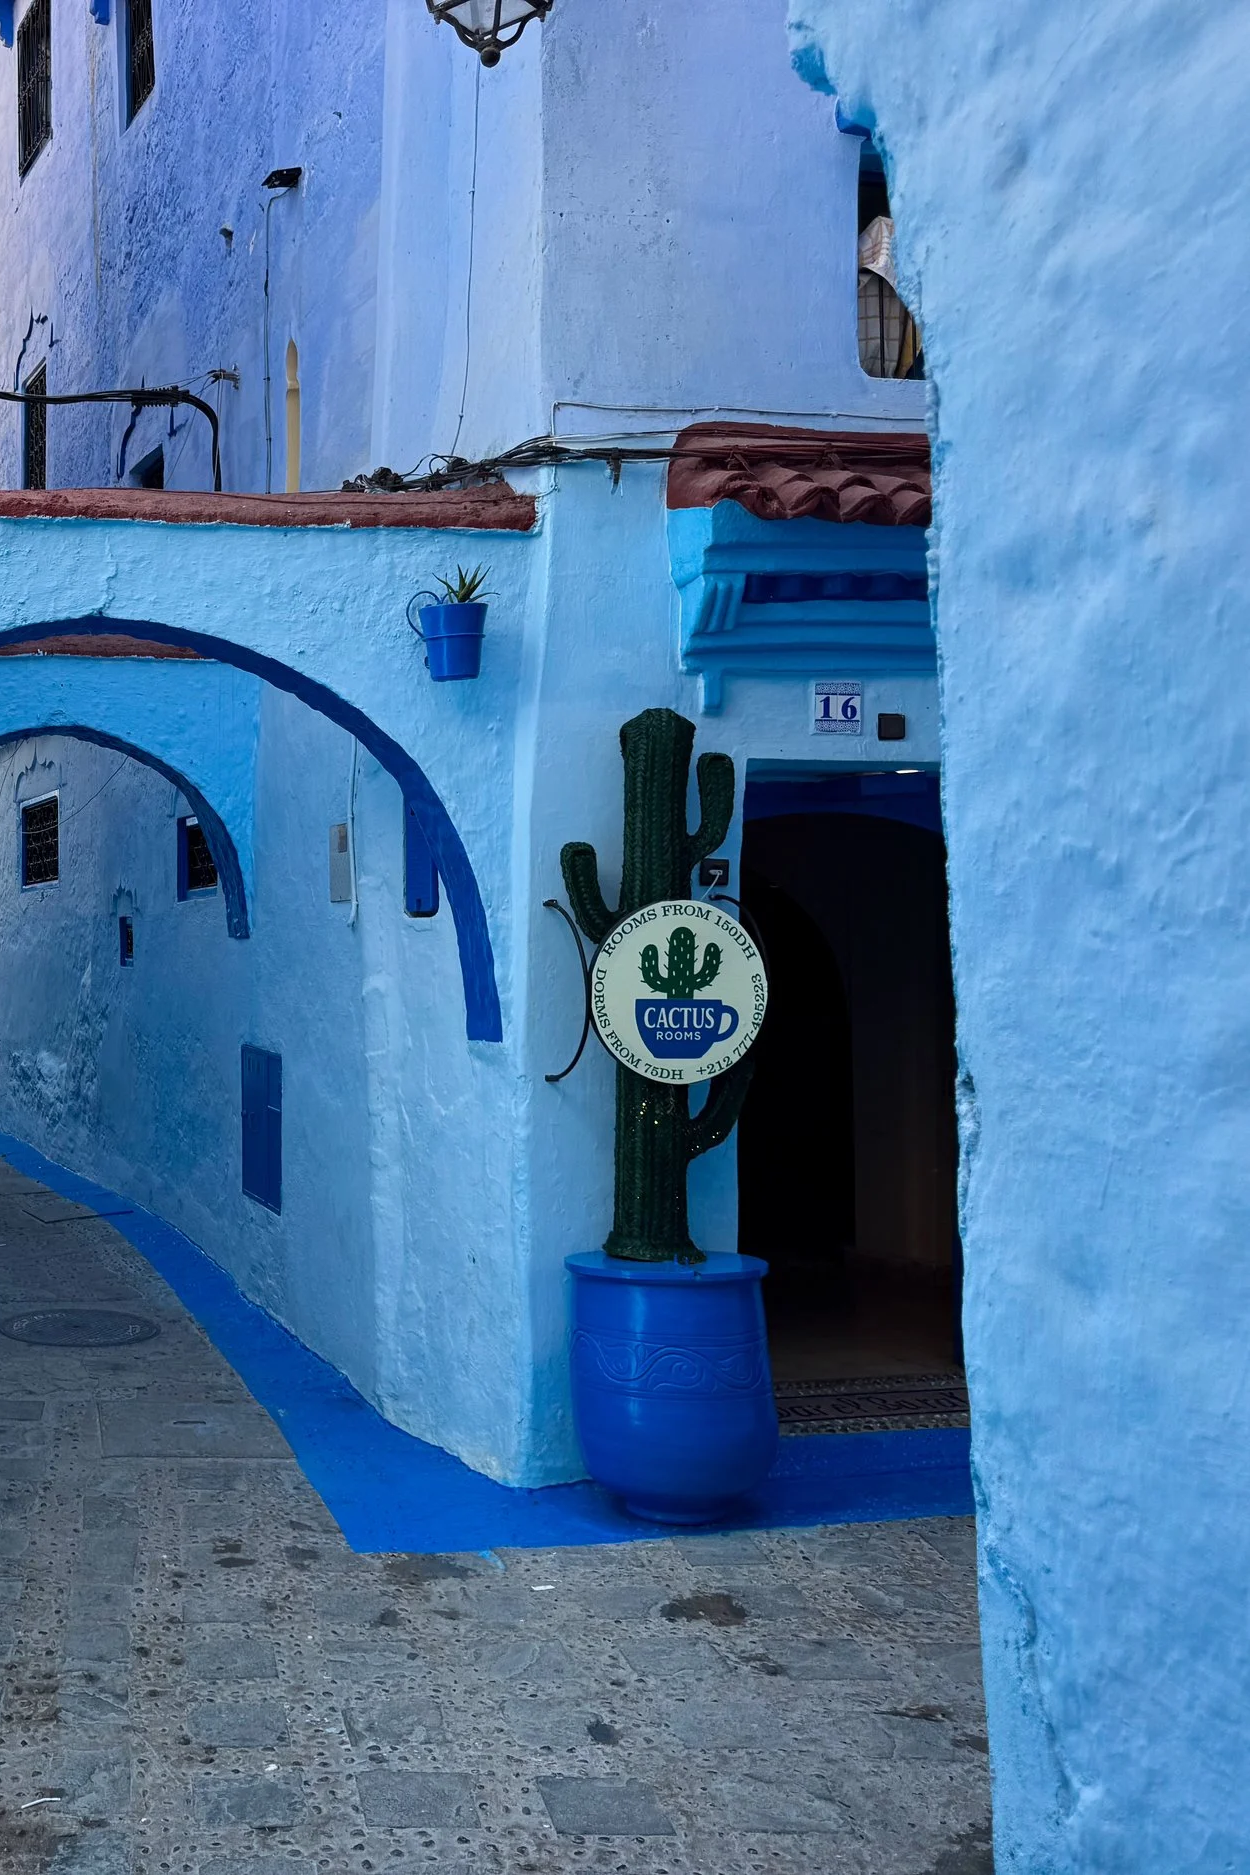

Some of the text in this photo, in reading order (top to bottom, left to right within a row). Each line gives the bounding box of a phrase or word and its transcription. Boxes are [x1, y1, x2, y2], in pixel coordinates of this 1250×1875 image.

[819, 696, 857, 720] 16
[602, 905, 757, 961] ROOMS FROM 150DH
[594, 969, 683, 1080] DORMS FROM 75DH
[644, 1007, 714, 1029] CACTUS
[656, 1031, 701, 1041] ROOMS
[696, 1057, 733, 1076] +212
